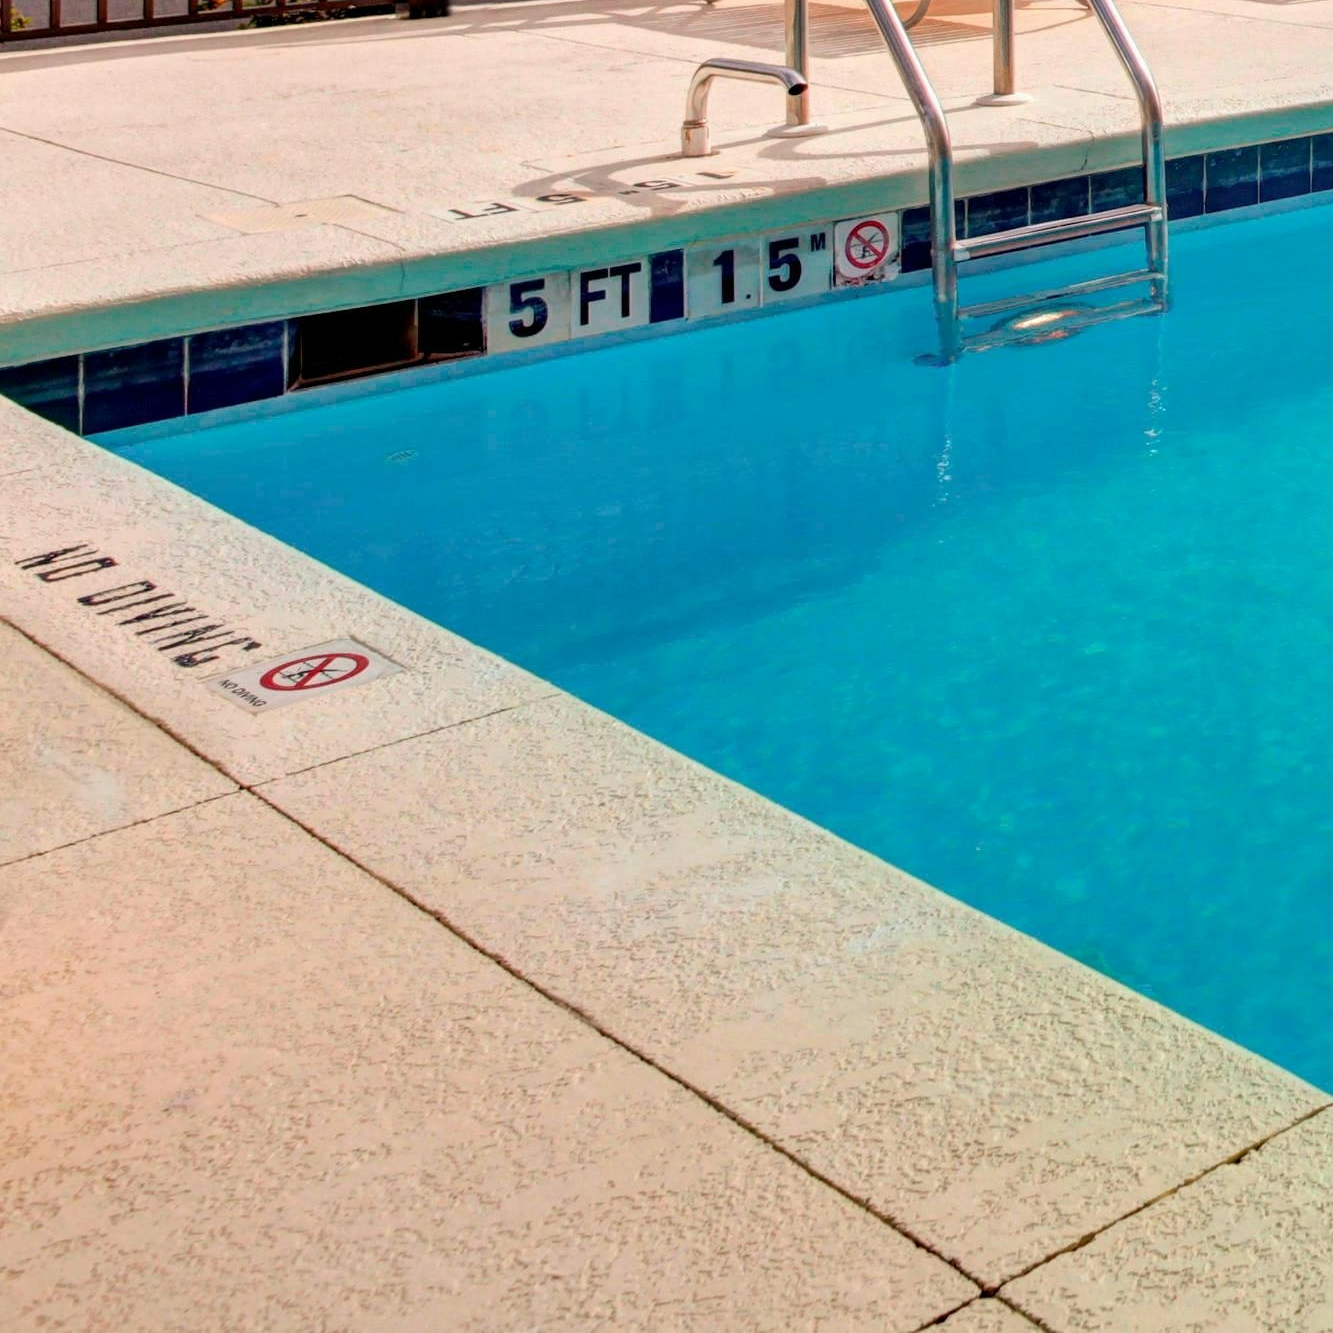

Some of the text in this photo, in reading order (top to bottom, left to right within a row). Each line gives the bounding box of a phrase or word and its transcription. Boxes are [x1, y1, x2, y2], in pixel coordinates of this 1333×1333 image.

[508, 278, 548, 338] 5
[579, 262, 642, 326] FT
[14, 544, 262, 668] NO DIVING
[218, 679, 267, 707] NO DIVING
